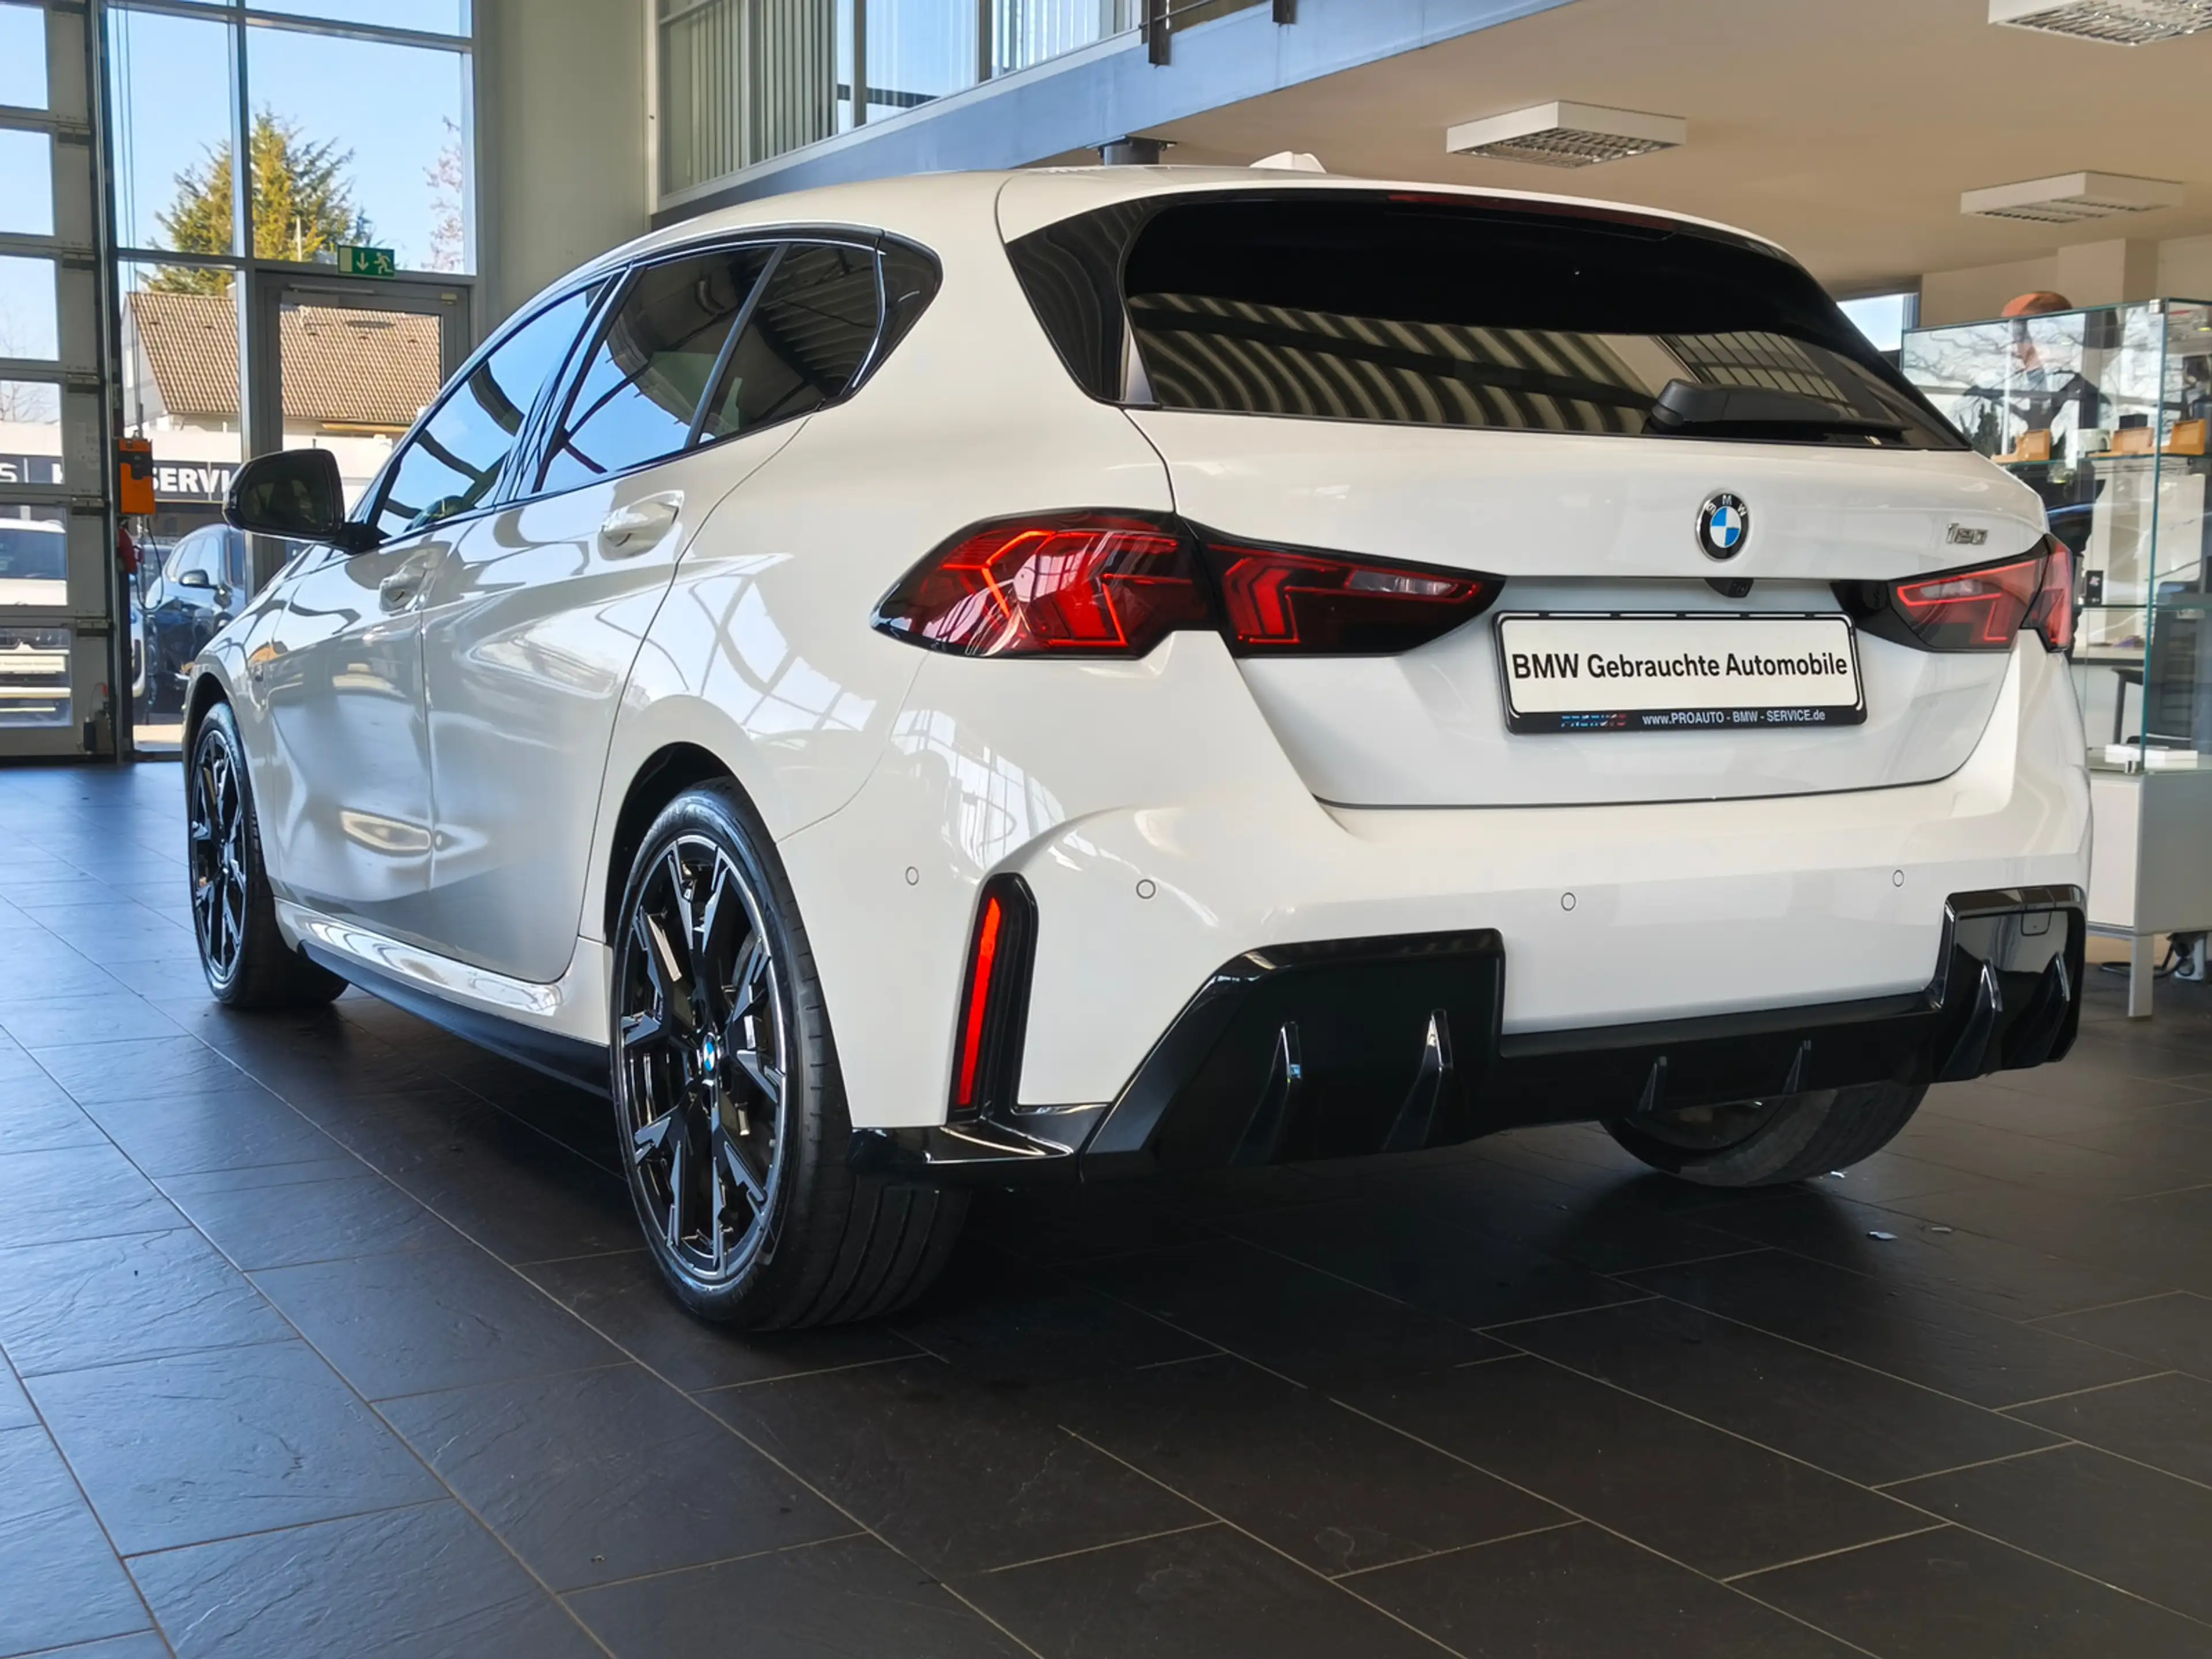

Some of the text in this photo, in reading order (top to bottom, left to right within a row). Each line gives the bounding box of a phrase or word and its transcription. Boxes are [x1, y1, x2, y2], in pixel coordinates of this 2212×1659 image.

[1706, 494, 1747, 517] BMW
[1512, 652, 1847, 679] BMW Gebrauchte Automobile
[1642, 711, 1724, 725] www.PROAUTO
[1733, 710, 1758, 723] BMW
[1767, 709, 1825, 722] SERVICE.de
